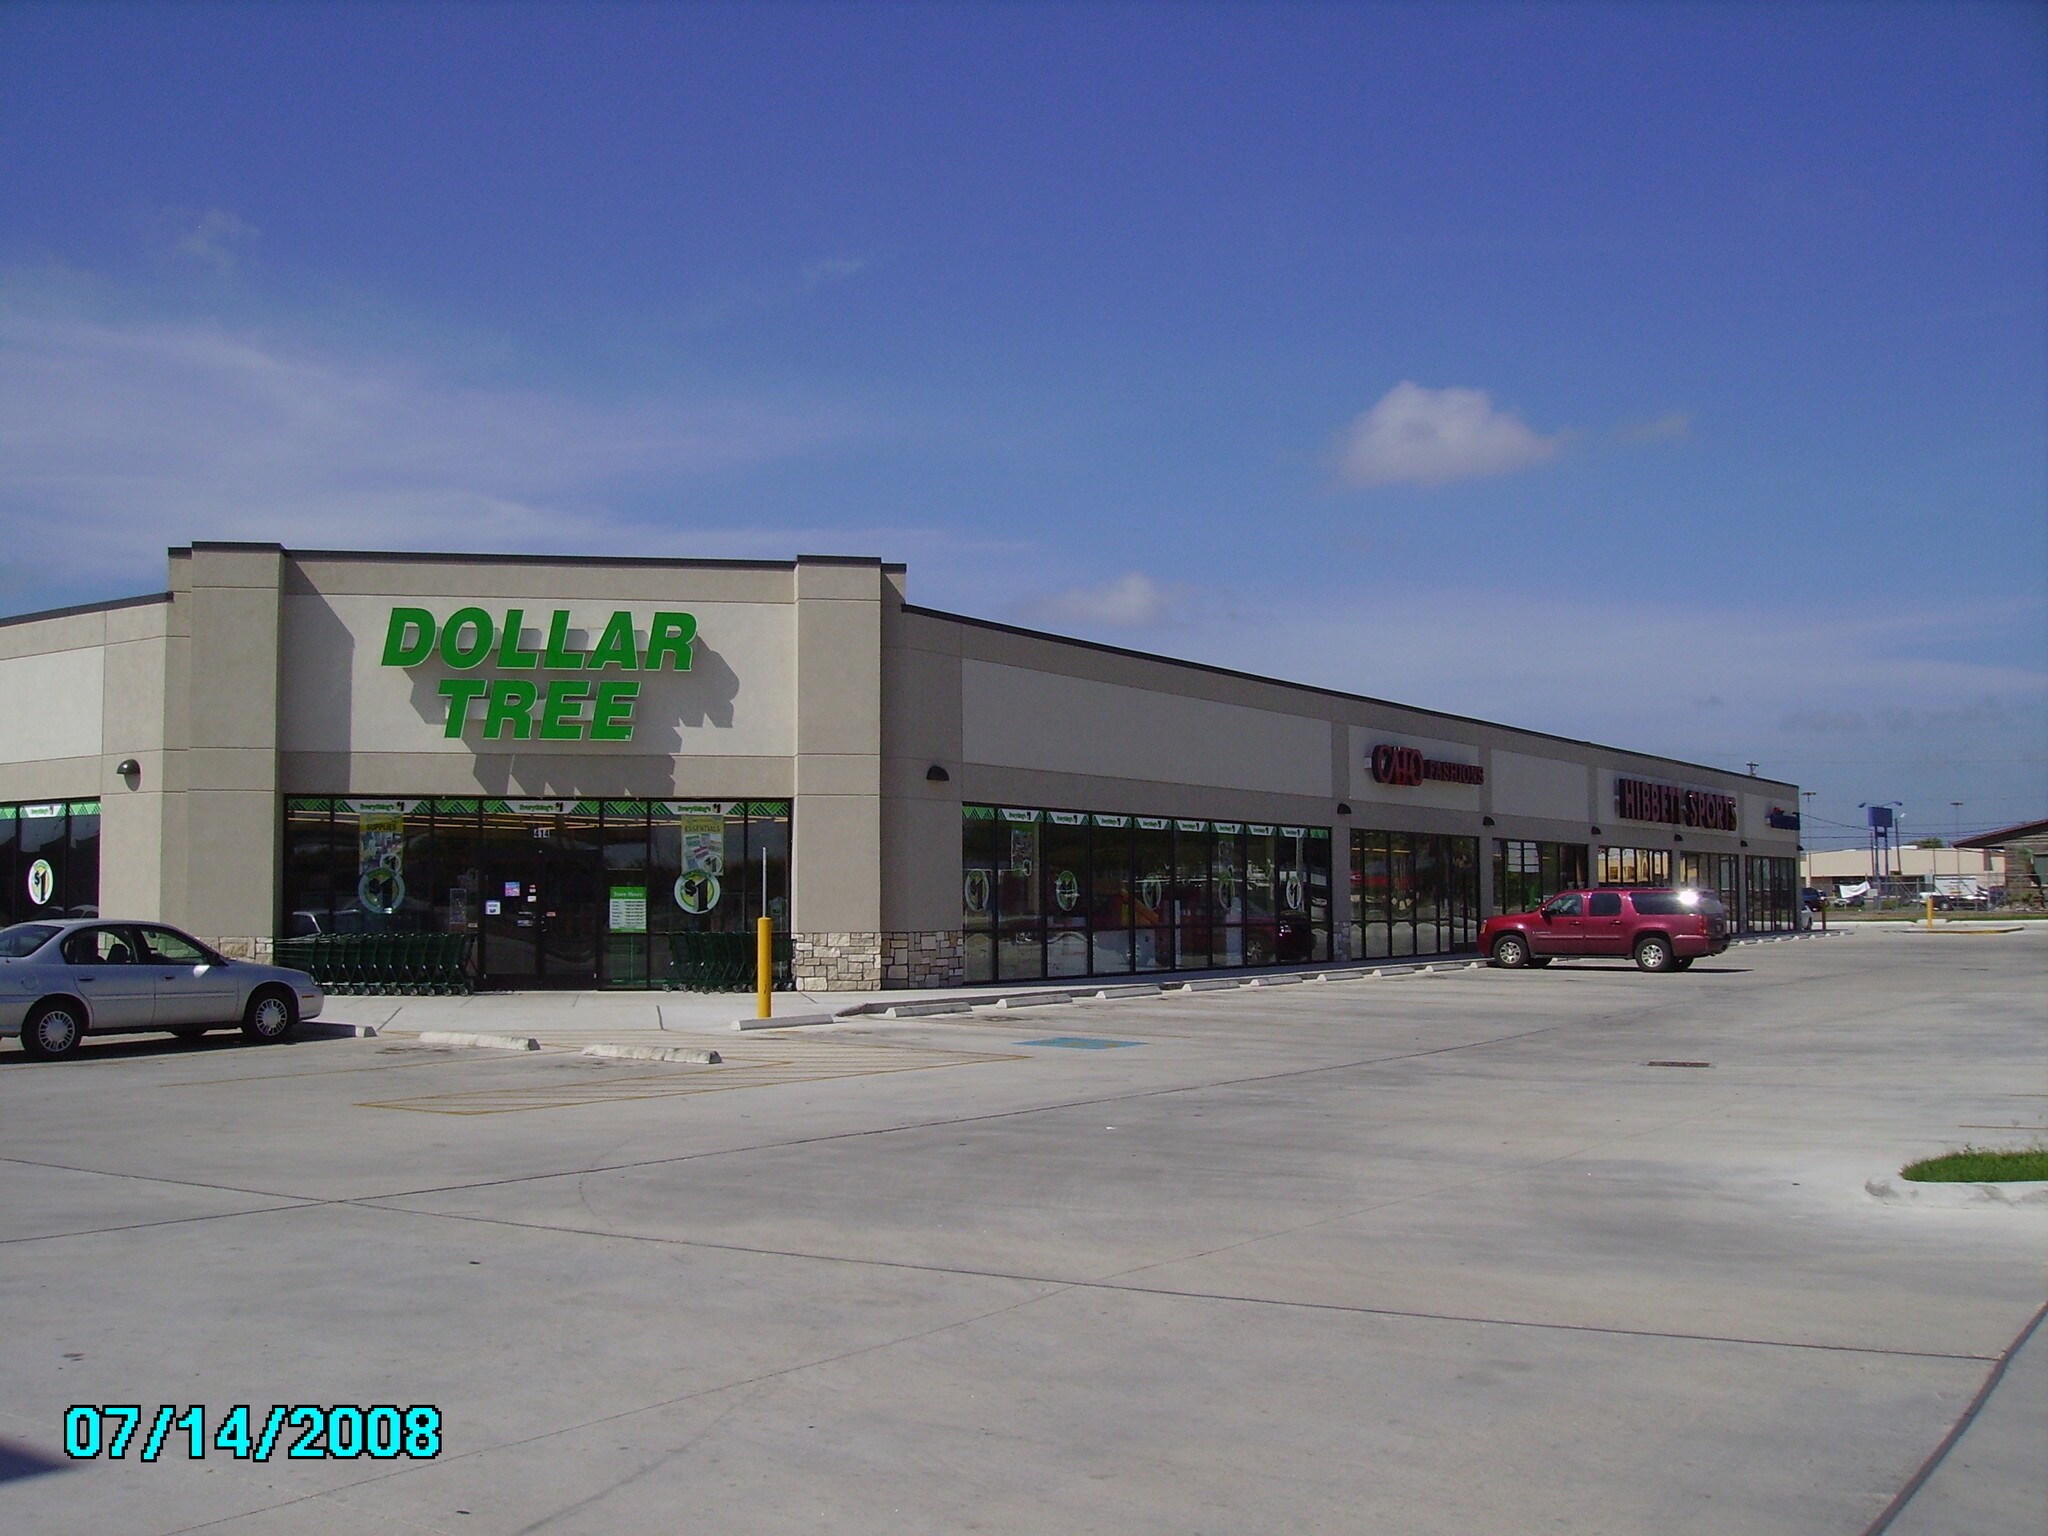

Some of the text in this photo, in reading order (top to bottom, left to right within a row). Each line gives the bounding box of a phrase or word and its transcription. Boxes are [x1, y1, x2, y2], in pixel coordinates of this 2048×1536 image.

[381, 606, 698, 671] DOLLAR
[437, 679, 641, 741] TREE
[1429, 760, 1485, 785] FASHIONS
[1620, 779, 1683, 824] HIBBETT
[1685, 790, 1738, 831] SPORTS
[684, 878, 709, 912] $1
